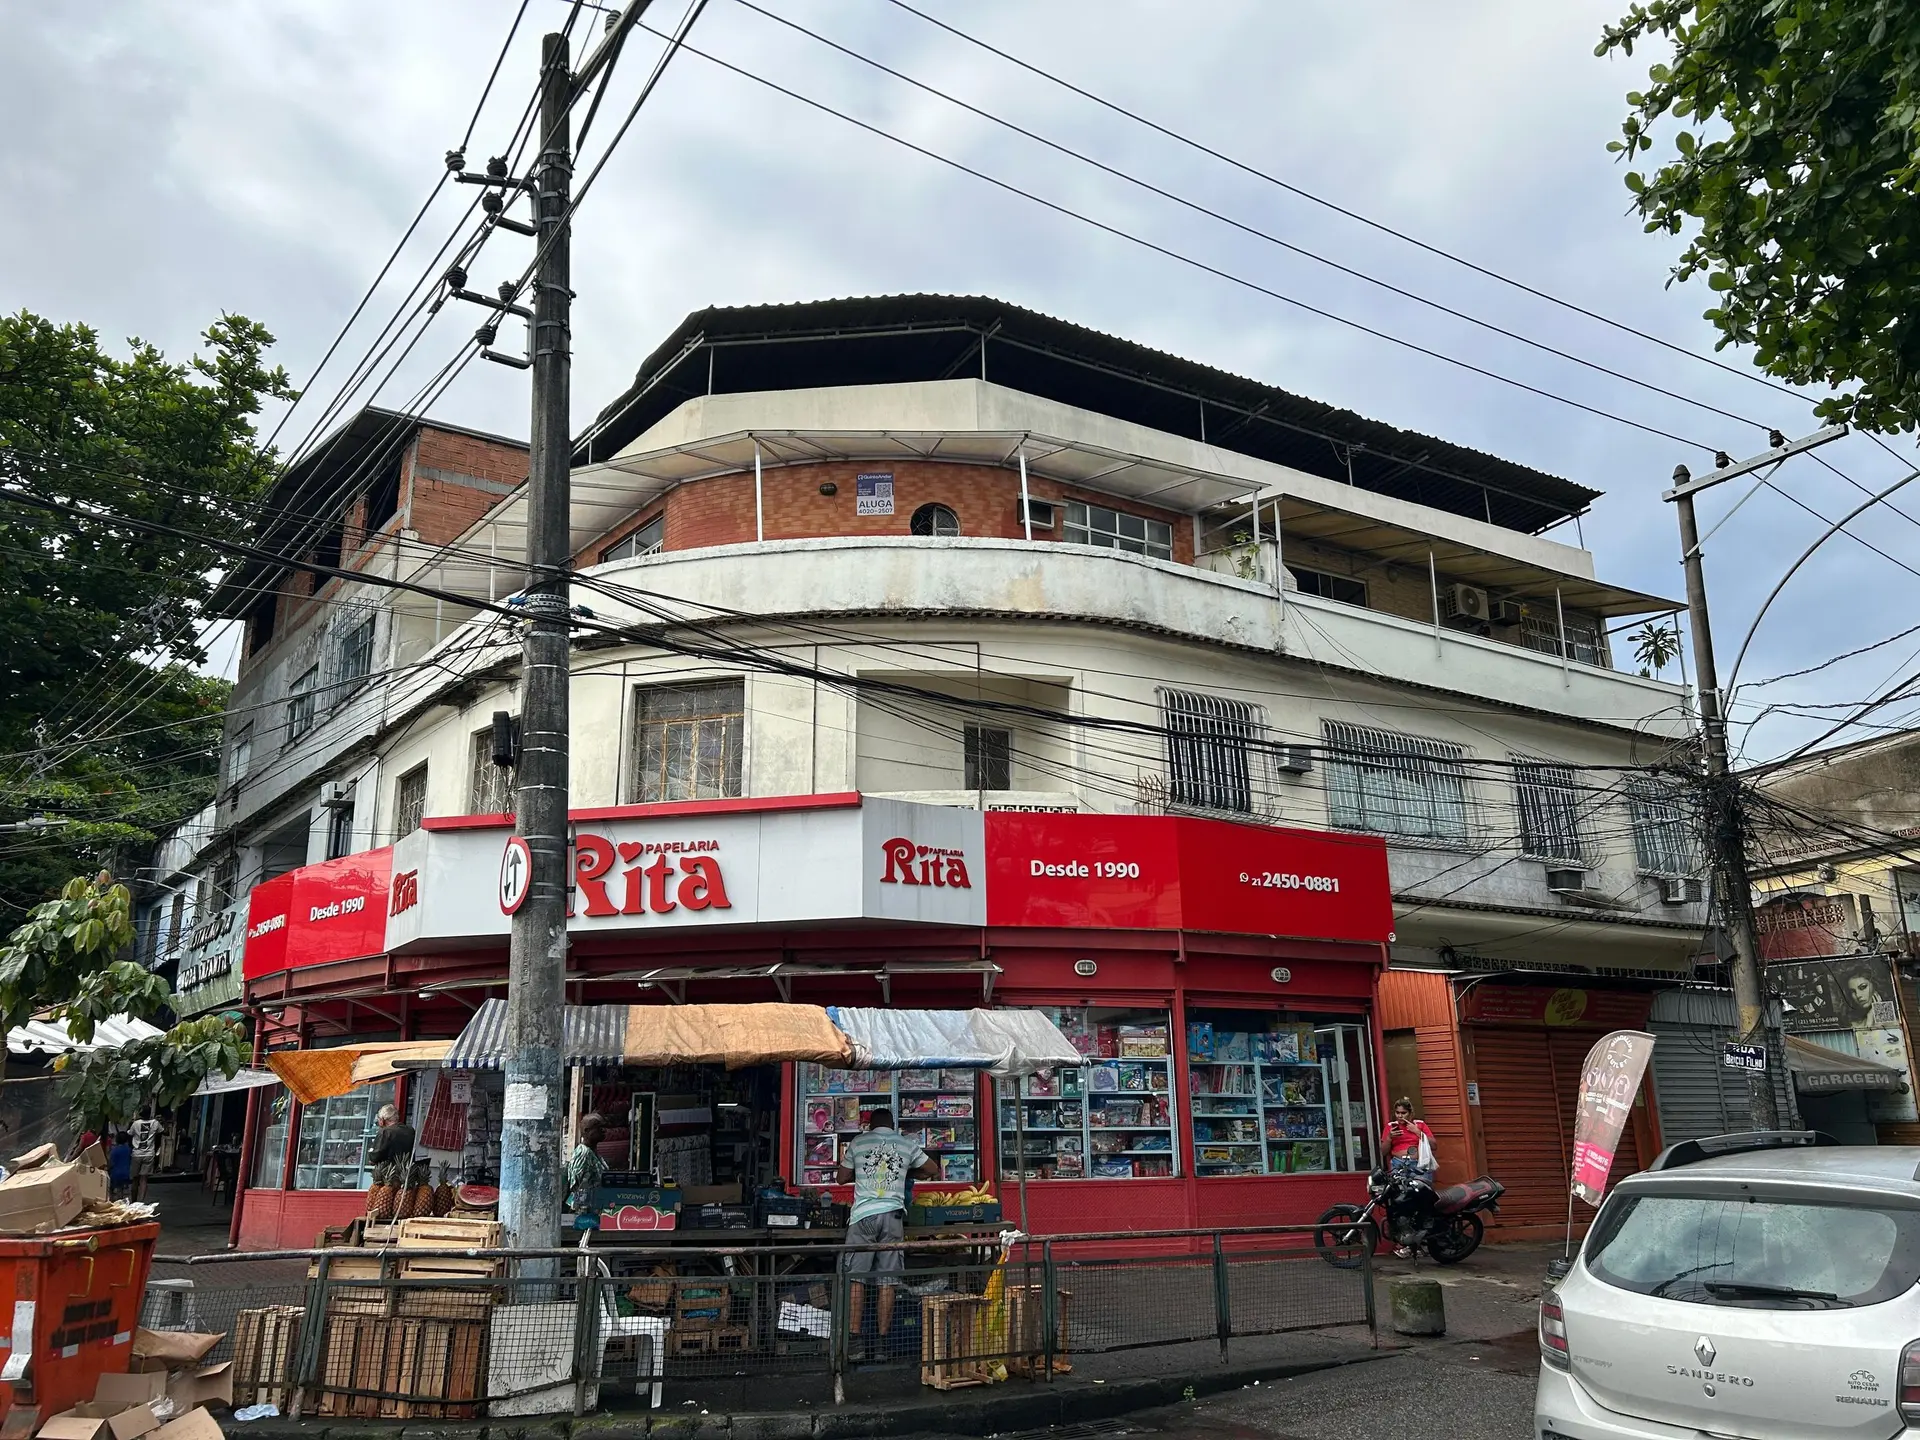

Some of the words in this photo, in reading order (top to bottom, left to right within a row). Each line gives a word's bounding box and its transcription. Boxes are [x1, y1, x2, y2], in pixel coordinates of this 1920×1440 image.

[859, 500, 892, 509] ALUGA
[645, 840, 720, 855] PAPELARIA
[929, 847, 964, 857] PAPELARIA
[880, 837, 971, 889] Rita
[1030, 860, 1089, 878] Desde
[1093, 861, 1140, 879] 1990
[567, 833, 732, 918] Rita
[1251, 878, 1262, 887] 21
[1262, 872, 1340, 893] 2450-0881
[389, 872, 418, 917] Rita
[310, 900, 339, 922] Desde
[341, 896, 365, 914] 1990
[1732, 1045, 1755, 1054] RUA
[1607, 1056, 1628, 1069] OUTLET
[1808, 1073, 1890, 1086] GARAGEM
[1666, 1365, 1754, 1387] SANDERO
[1835, 1396, 1890, 1407] RENAULT
